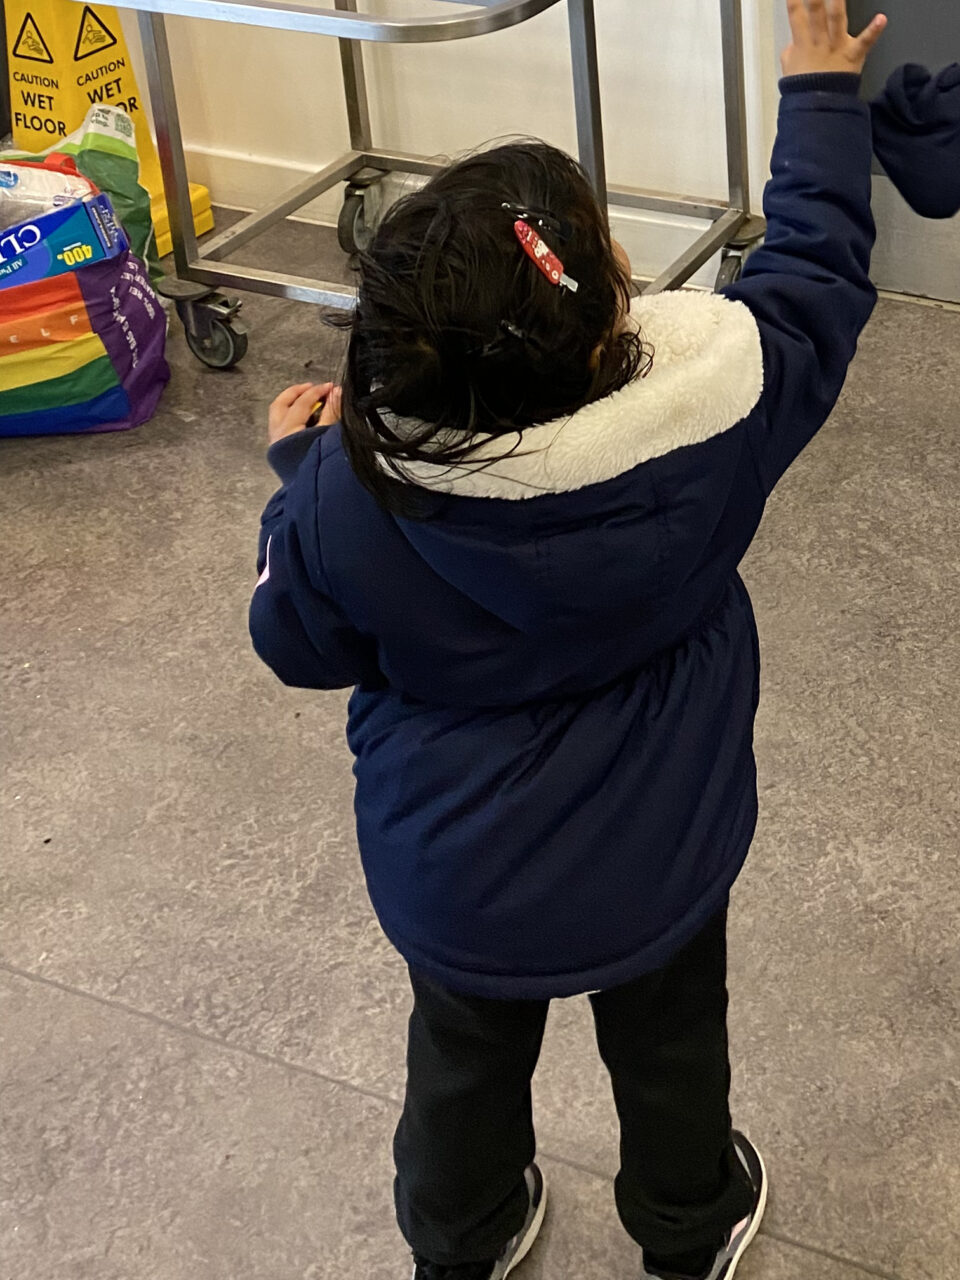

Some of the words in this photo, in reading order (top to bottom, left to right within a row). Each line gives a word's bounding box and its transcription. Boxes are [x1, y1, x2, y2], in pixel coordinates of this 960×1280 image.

[13, 71, 59, 89] CAUTION
[76, 57, 126, 87] CAUTION
[21, 90, 54, 111] WET
[87, 77, 122, 104] WET
[14, 112, 68, 138] FLOOR
